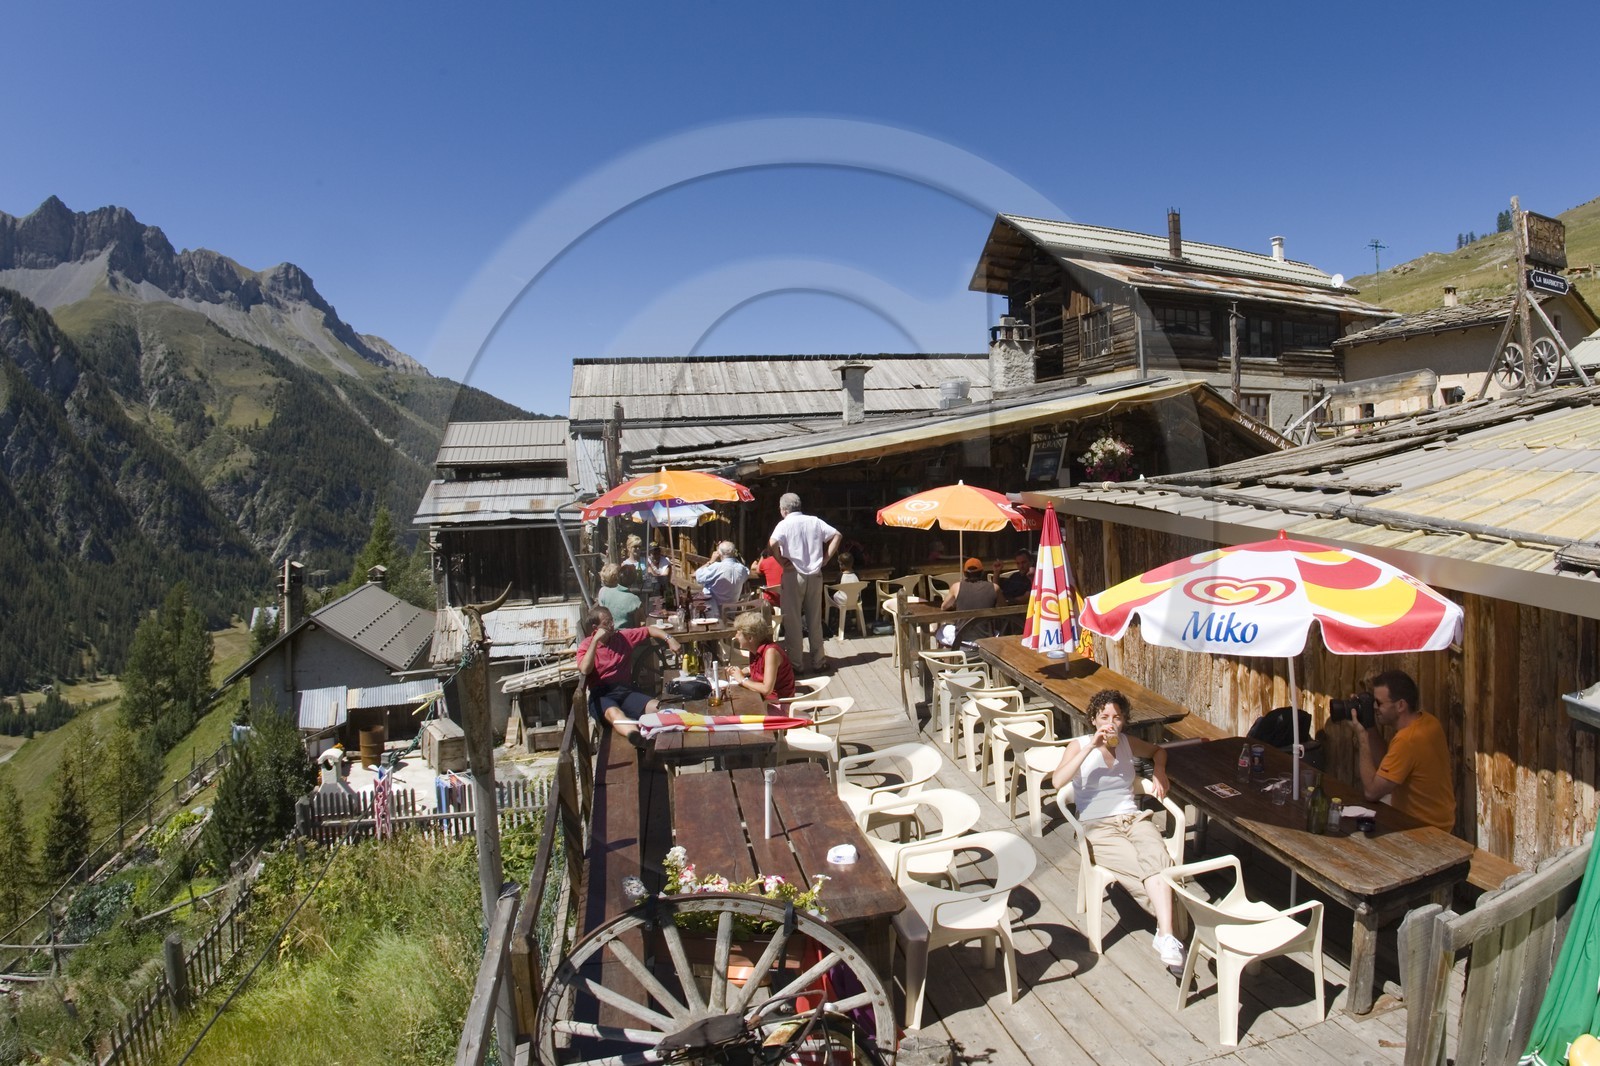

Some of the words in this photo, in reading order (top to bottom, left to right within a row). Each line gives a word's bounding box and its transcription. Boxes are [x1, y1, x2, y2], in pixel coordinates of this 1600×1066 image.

[1535, 275, 1543, 284] LA
[1542, 276, 1565, 290] MARMOTTE
[897, 514, 918, 525] MIKO
[1181, 610, 1259, 644] Miko
